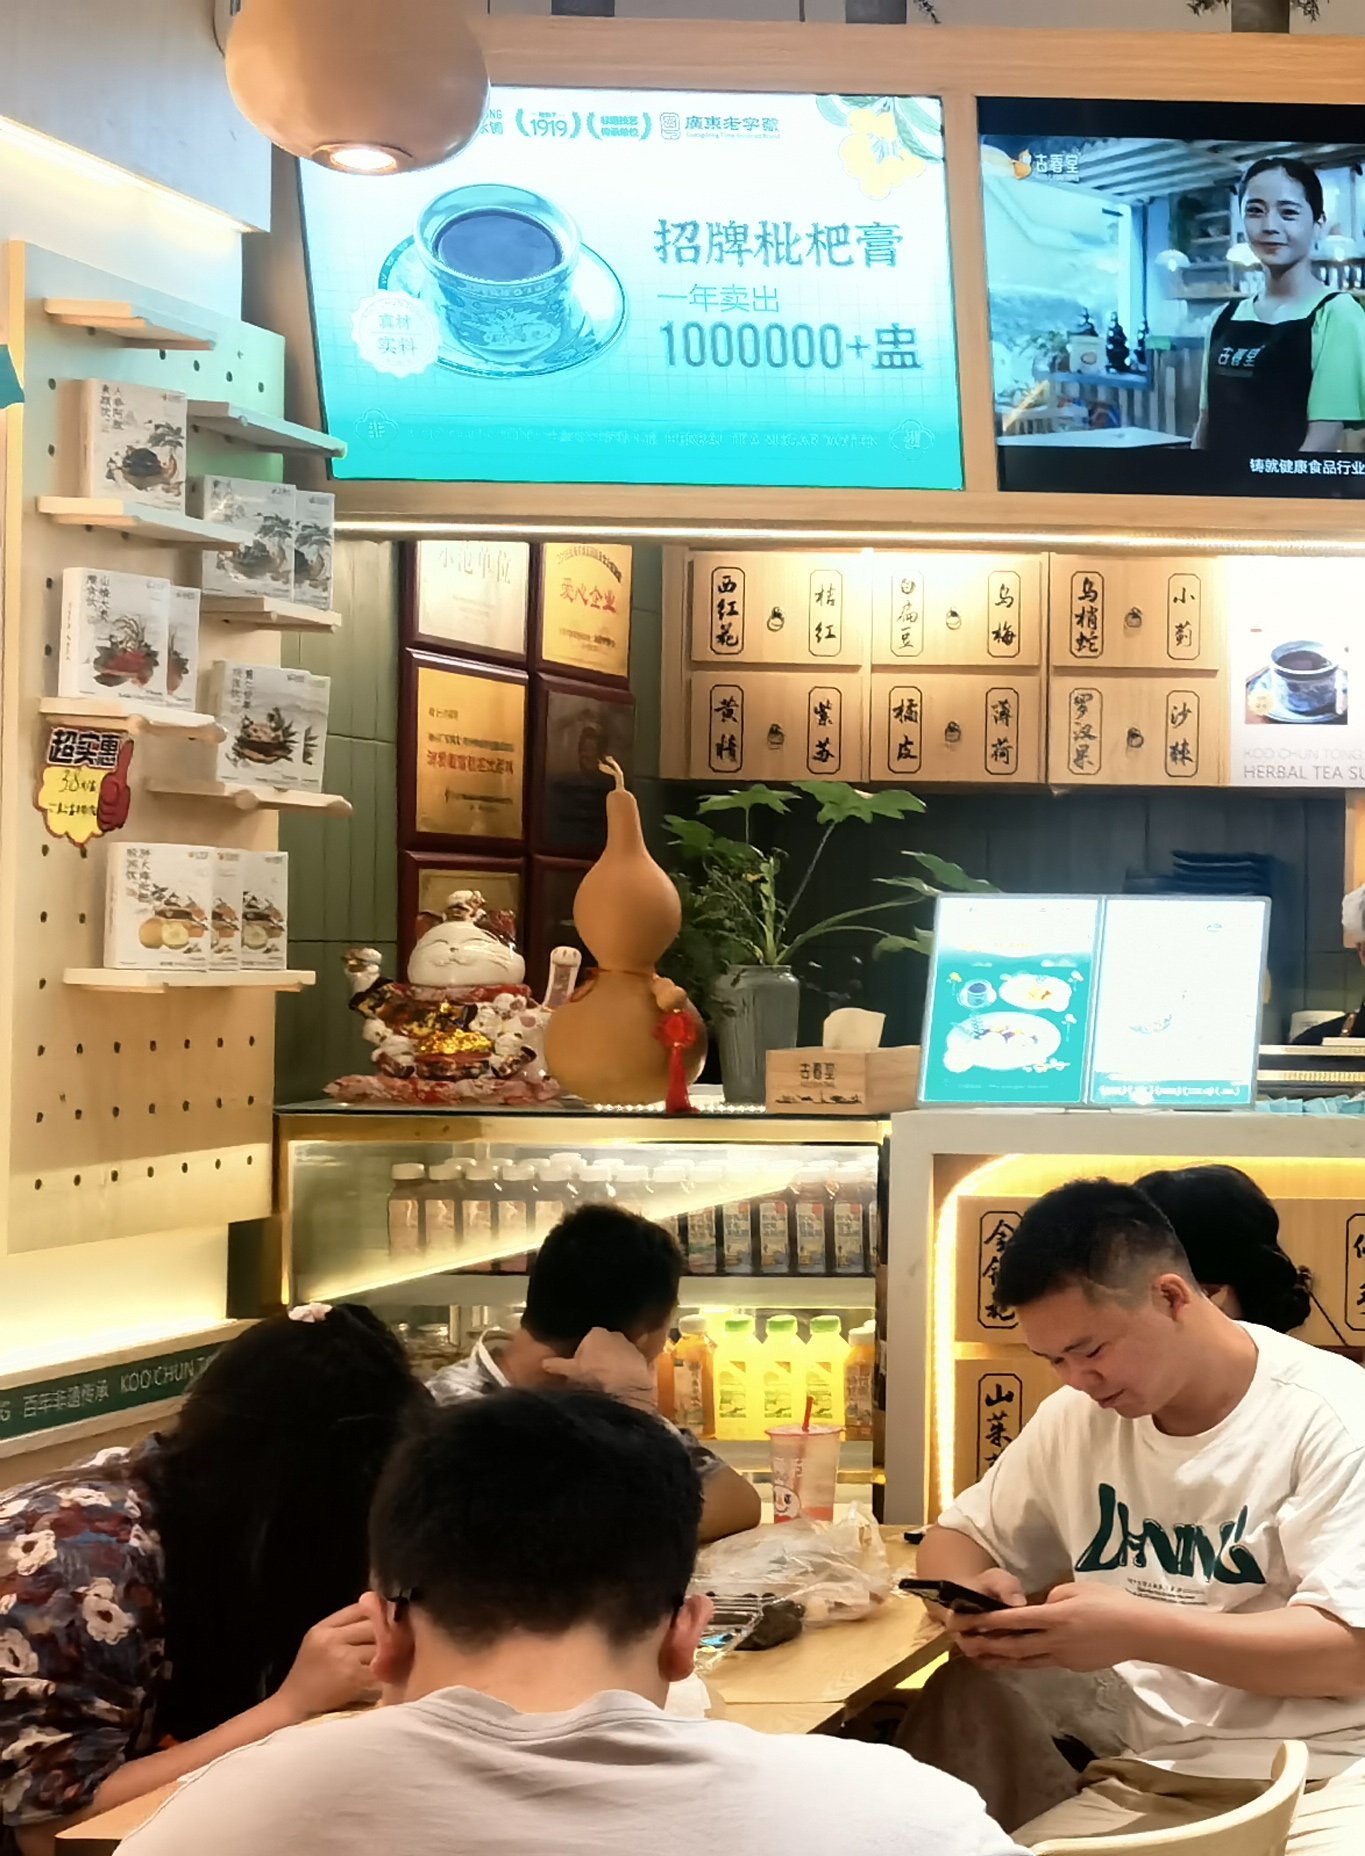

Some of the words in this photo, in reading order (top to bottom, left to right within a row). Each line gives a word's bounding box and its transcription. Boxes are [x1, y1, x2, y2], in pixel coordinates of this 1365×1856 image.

[531, 120, 567, 137] 1919
[1035, 153, 1078, 174] 古春堂
[653, 219, 903, 269] 招牌枇杷膏
[657, 284, 779, 314] 一年卖出
[659, 320, 922, 371] 1000000+盅
[560, 577, 616, 613] 爱心企业
[716, 576, 738, 647] 西红花
[992, 584, 1016, 644] 乌梅
[1074, 577, 1099, 652] 乌梢蛇
[48, 729, 120, 767] 超实惠
[715, 695, 738, 761] 黄精
[812, 698, 835, 762] 紫苏
[991, 698, 1013, 765] 薄荷
[1072, 693, 1098, 767] 罗汉果
[1169, 703, 1193, 766] 沙棘
[1243, 765, 1308, 781] HERBAL
[1314, 766, 1344, 781] TEA
[1279, 749, 1319, 762] CHUN
[1322, 749, 1363, 762] TONG
[120, 1368, 152, 1395] KOO
[154, 1361, 195, 1388] CHUN
